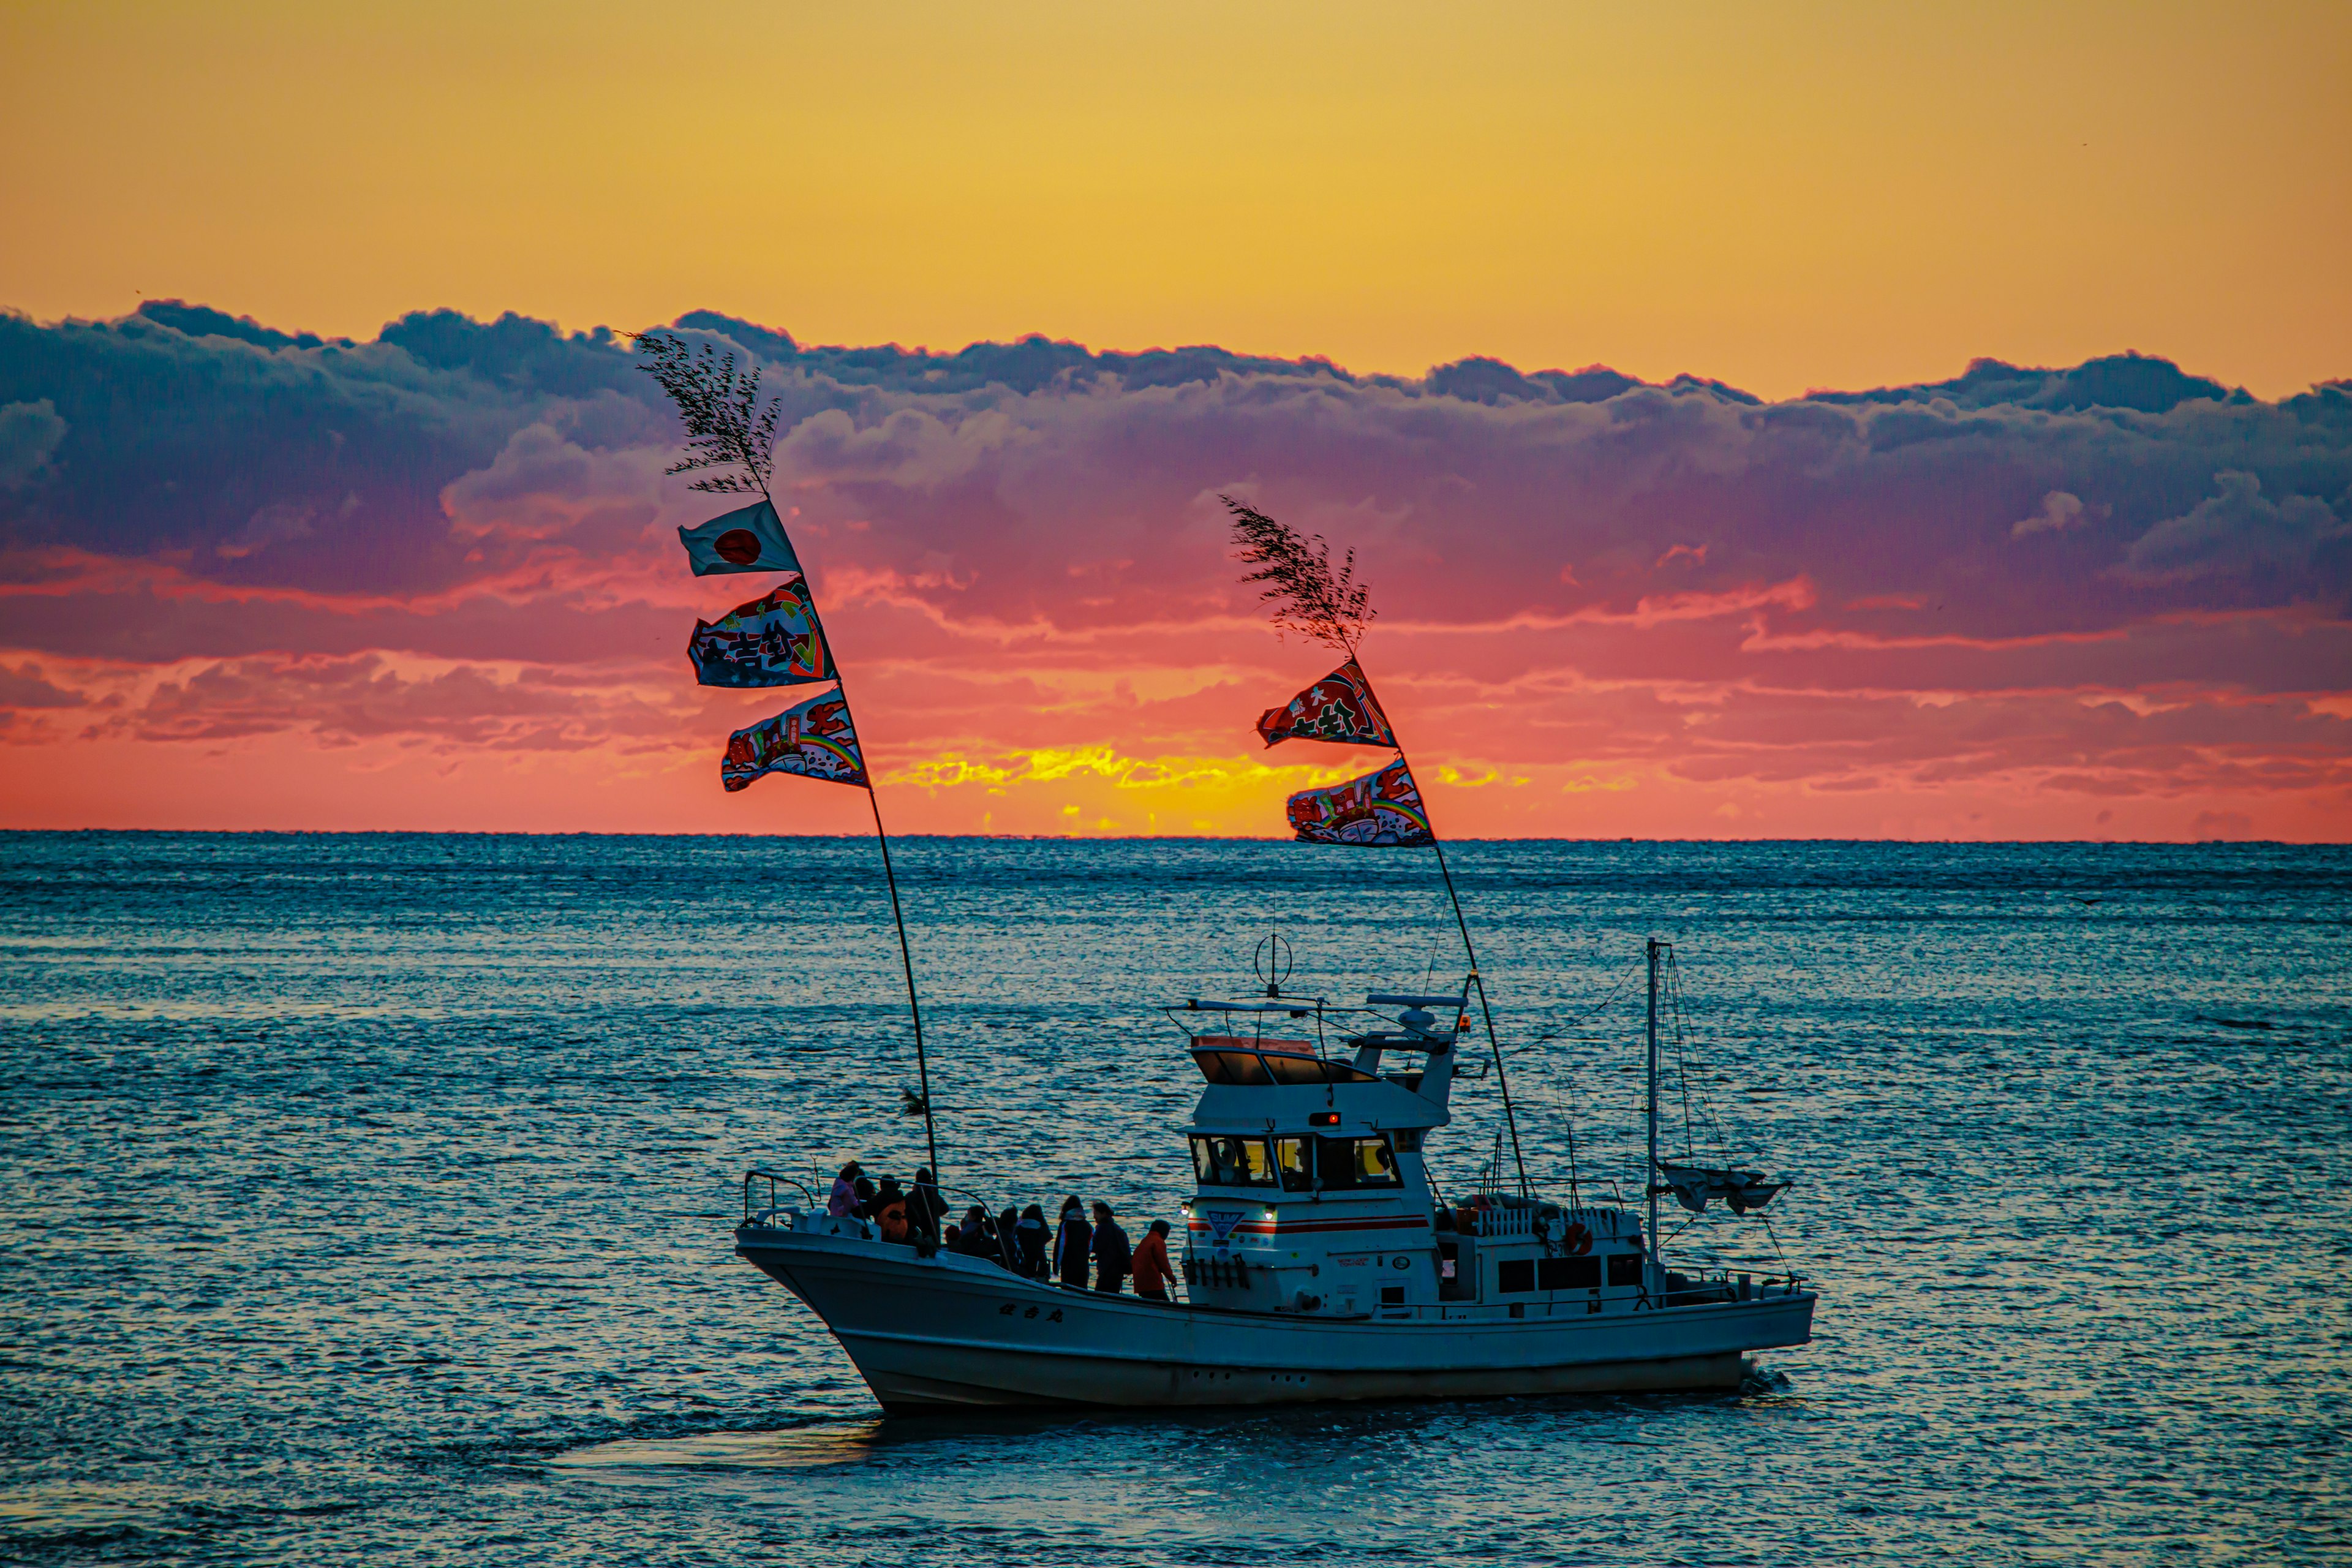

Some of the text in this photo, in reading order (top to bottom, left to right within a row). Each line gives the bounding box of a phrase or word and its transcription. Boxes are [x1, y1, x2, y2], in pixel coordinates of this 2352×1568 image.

[1210, 1213, 1240, 1223] SUMI
[998, 1303, 1064, 1323] 住吉丸
